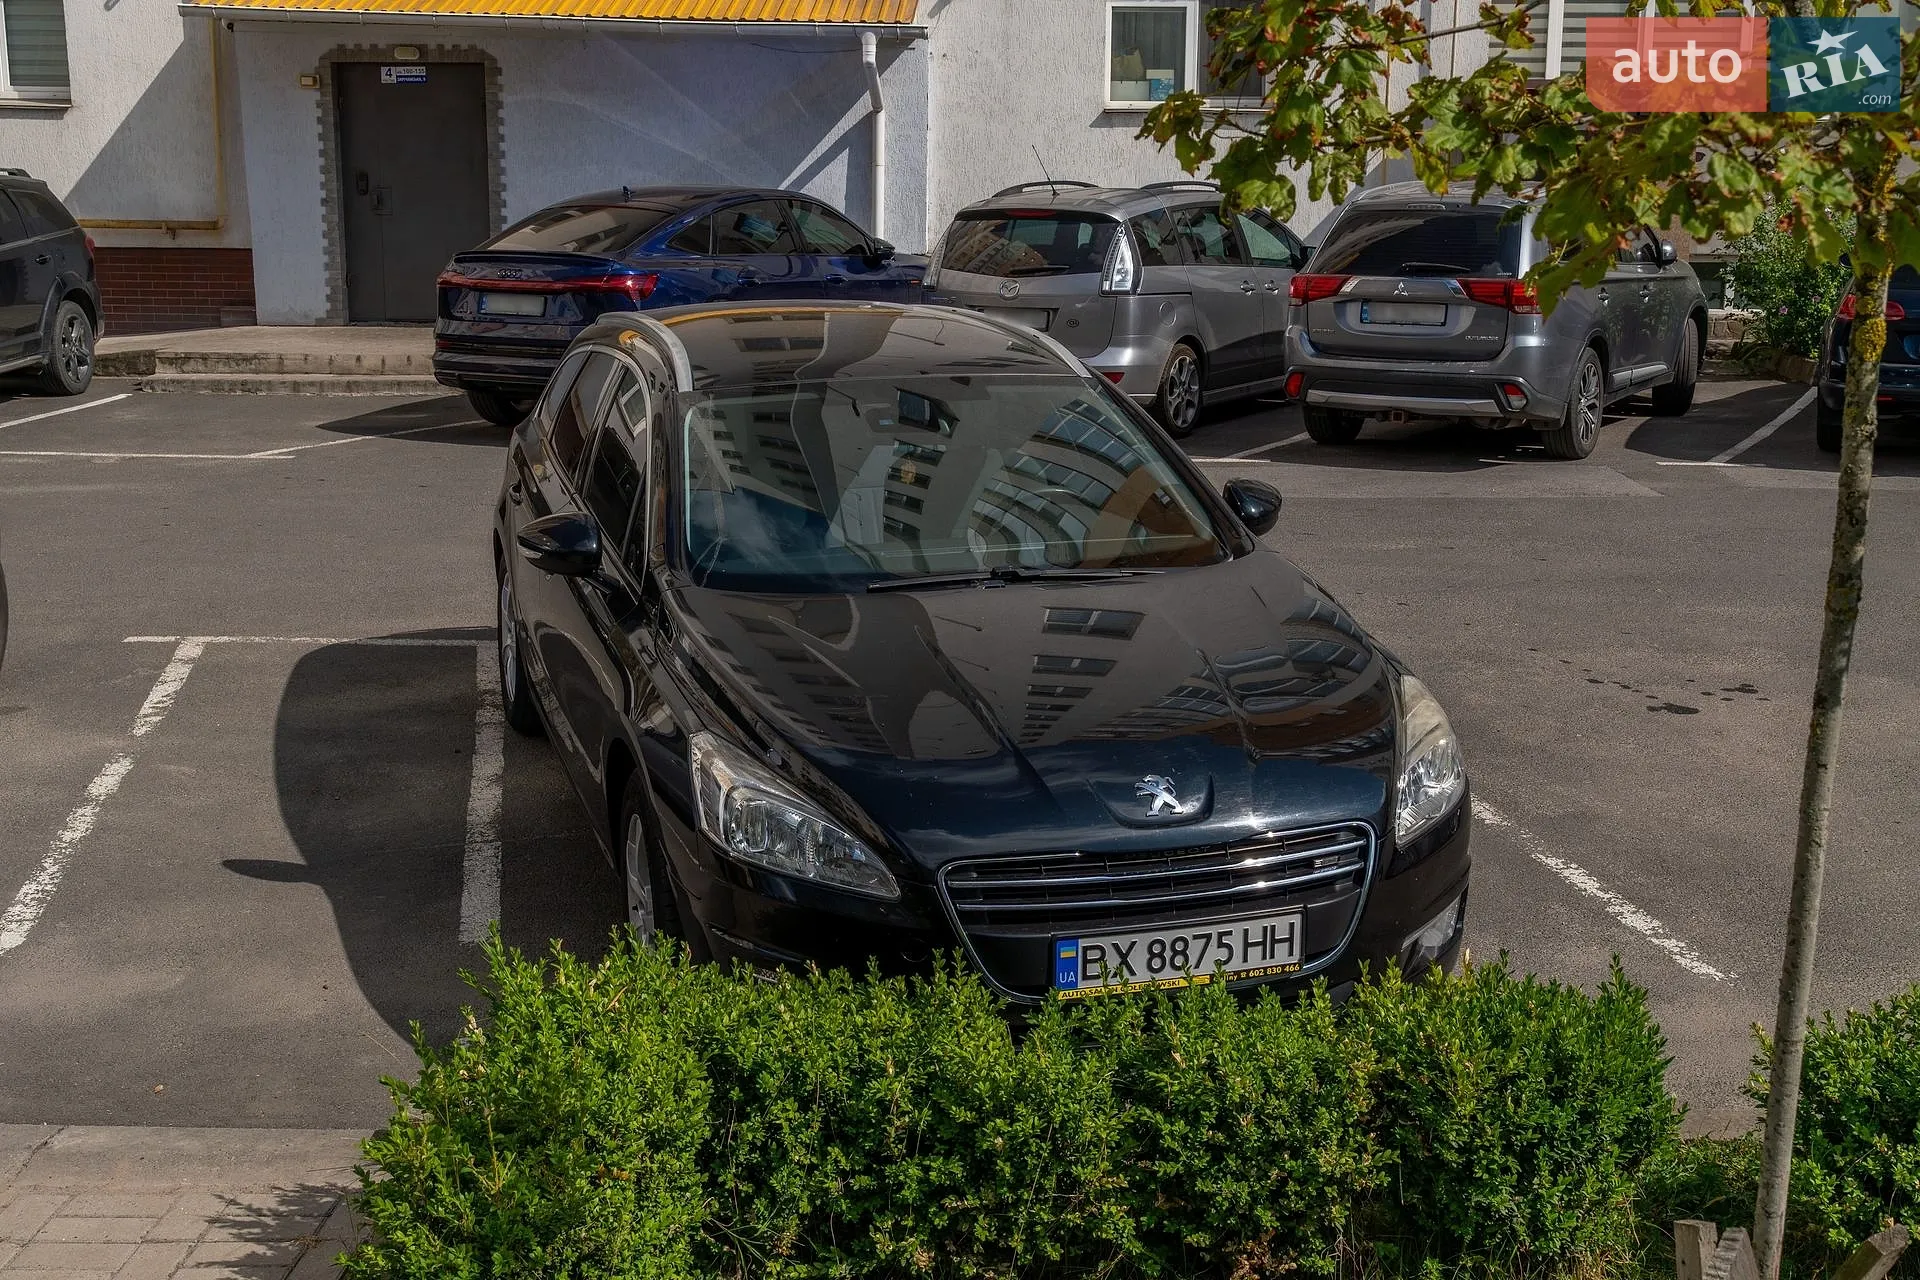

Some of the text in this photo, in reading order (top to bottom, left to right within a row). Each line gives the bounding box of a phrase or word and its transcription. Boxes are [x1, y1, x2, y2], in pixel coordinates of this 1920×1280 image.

[385, 67, 393, 78] 4
[1081, 921, 1296, 981] BX 8875 HH
[1249, 964, 1300, 977] 602 830 466
[1060, 971, 1076, 983] UA
